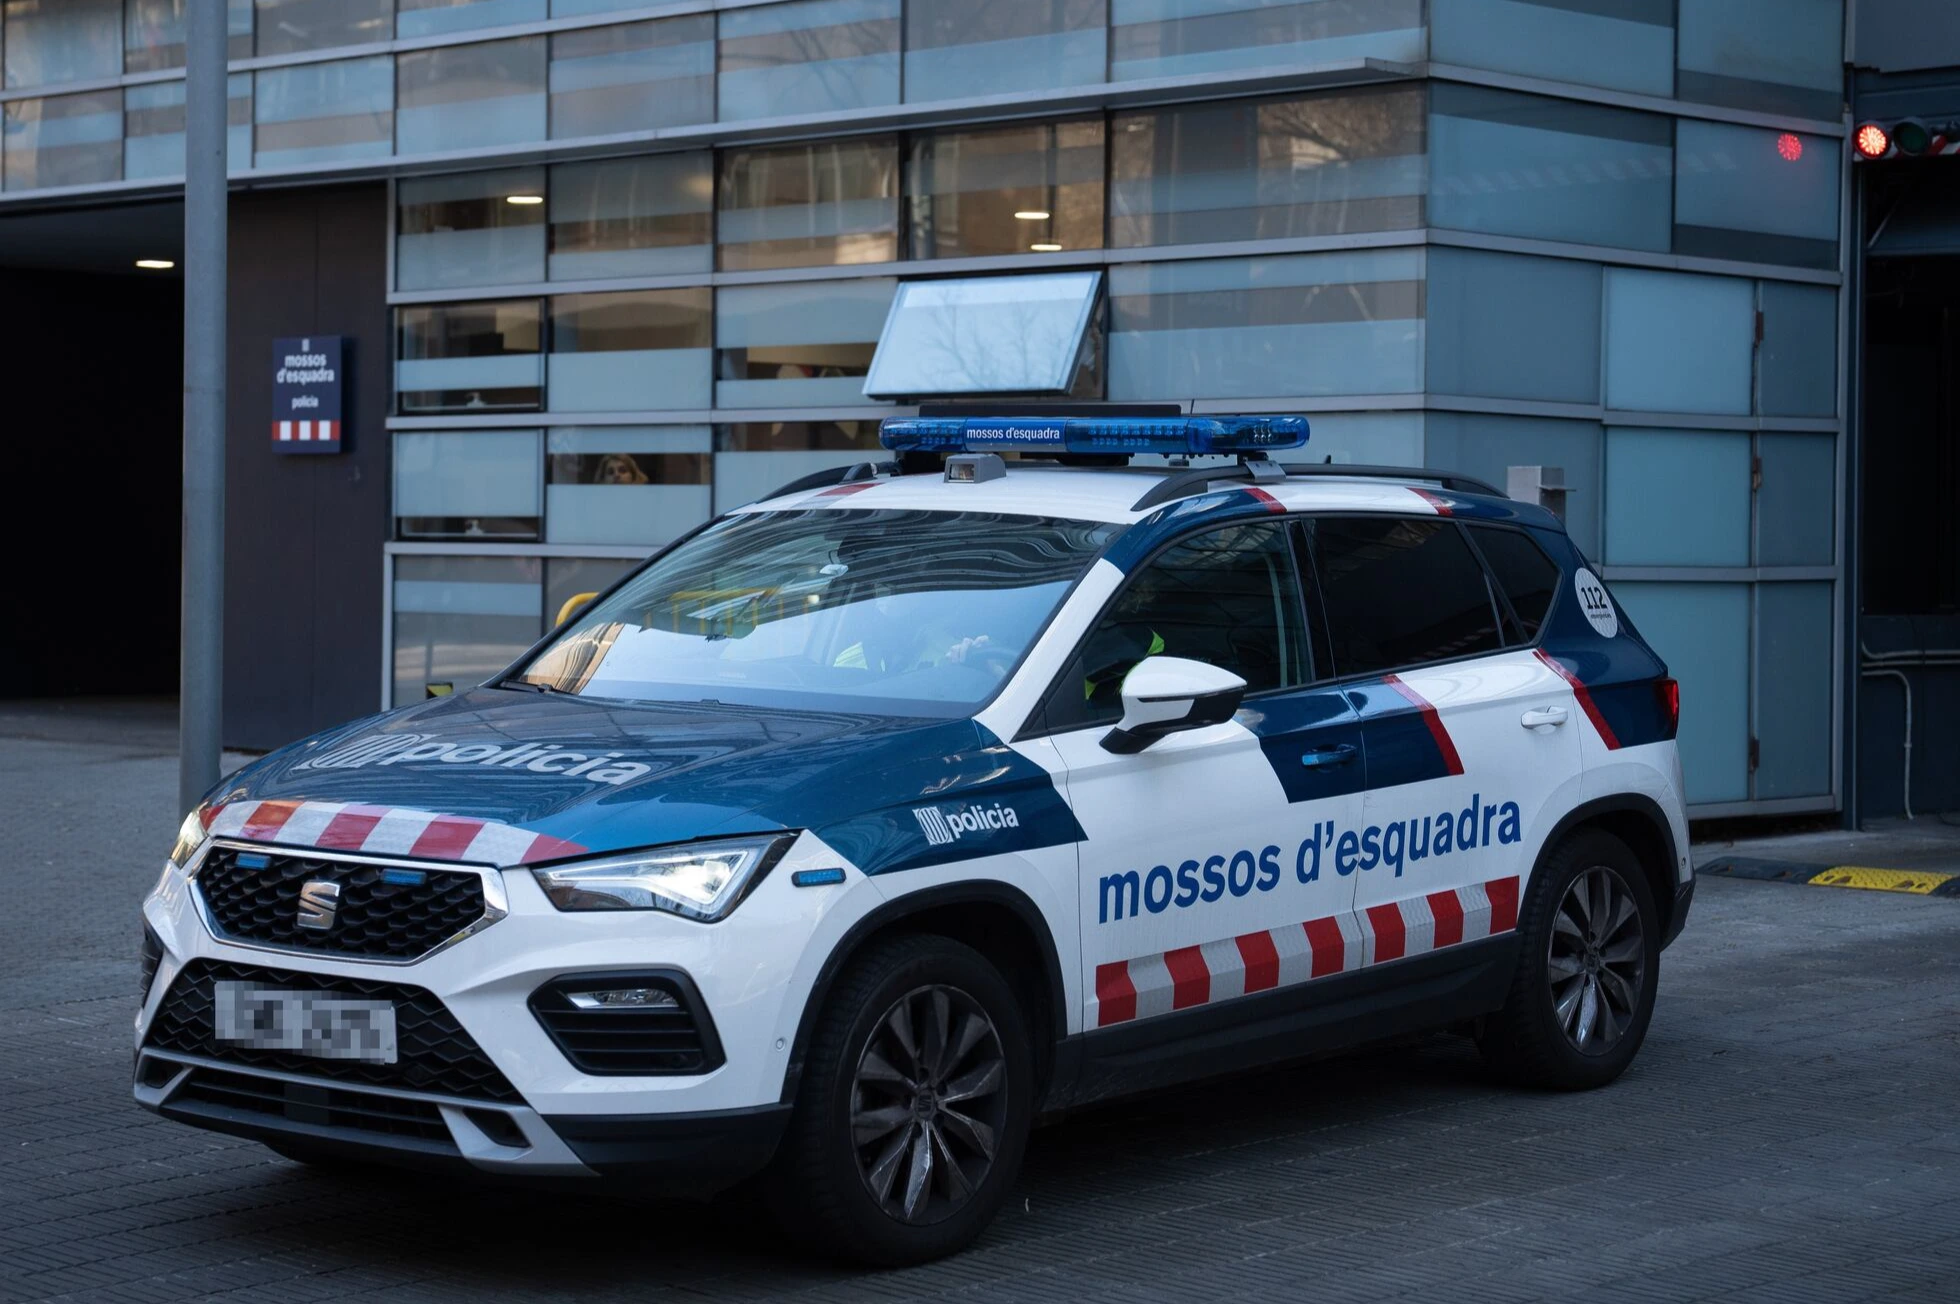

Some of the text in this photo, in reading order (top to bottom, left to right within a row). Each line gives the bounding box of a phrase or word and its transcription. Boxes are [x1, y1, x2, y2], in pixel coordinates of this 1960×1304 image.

[285, 354, 327, 368] mossos
[277, 367, 335, 386] d'esquadra
[291, 395, 319, 410] policia
[966, 426, 1061, 441] mossos d'esquadra
[1581, 586, 1608, 609] 112
[377, 739, 652, 786] policia
[945, 802, 1020, 840] policia
[1099, 793, 1522, 924] mossos d'esquadra
